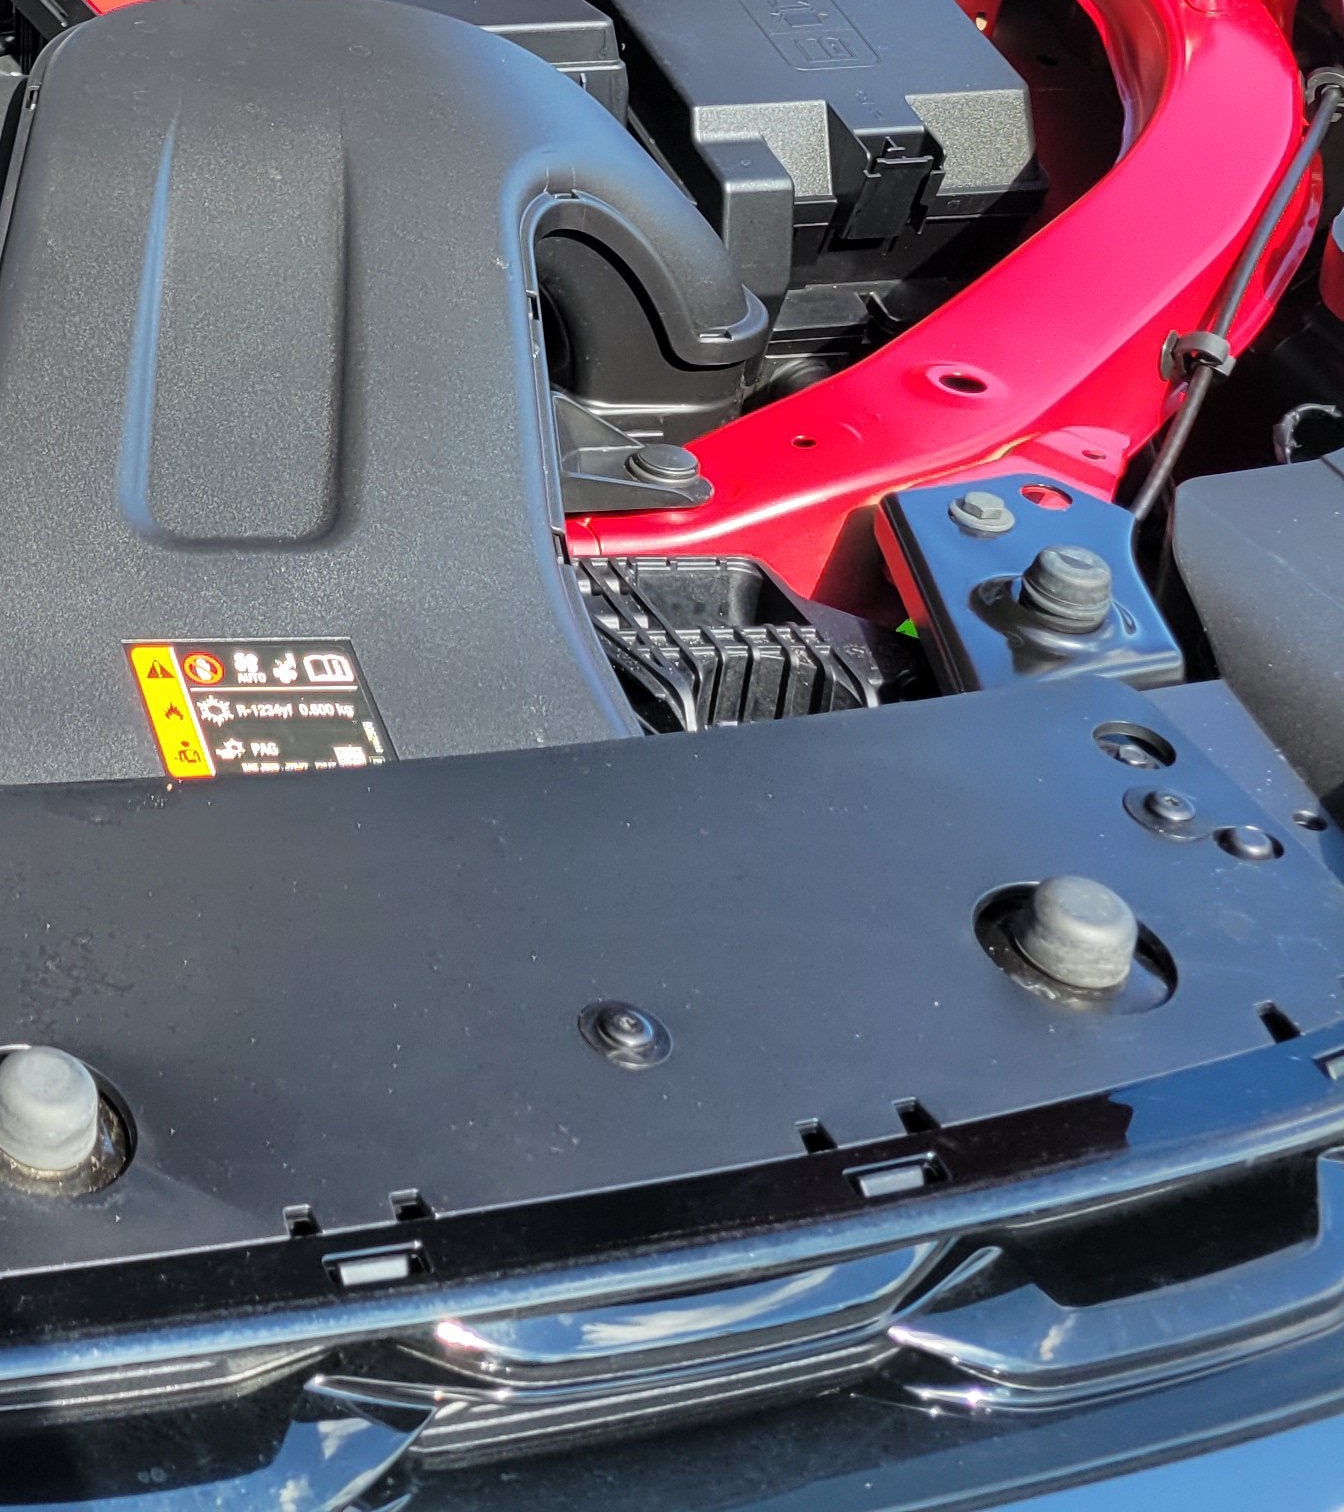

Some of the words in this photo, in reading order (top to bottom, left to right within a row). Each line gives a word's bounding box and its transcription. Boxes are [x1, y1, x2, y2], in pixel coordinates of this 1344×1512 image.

[237, 672, 267, 684] AUTO
[235, 702, 293, 719] R-1234yf
[250, 742, 280, 757] PAG
